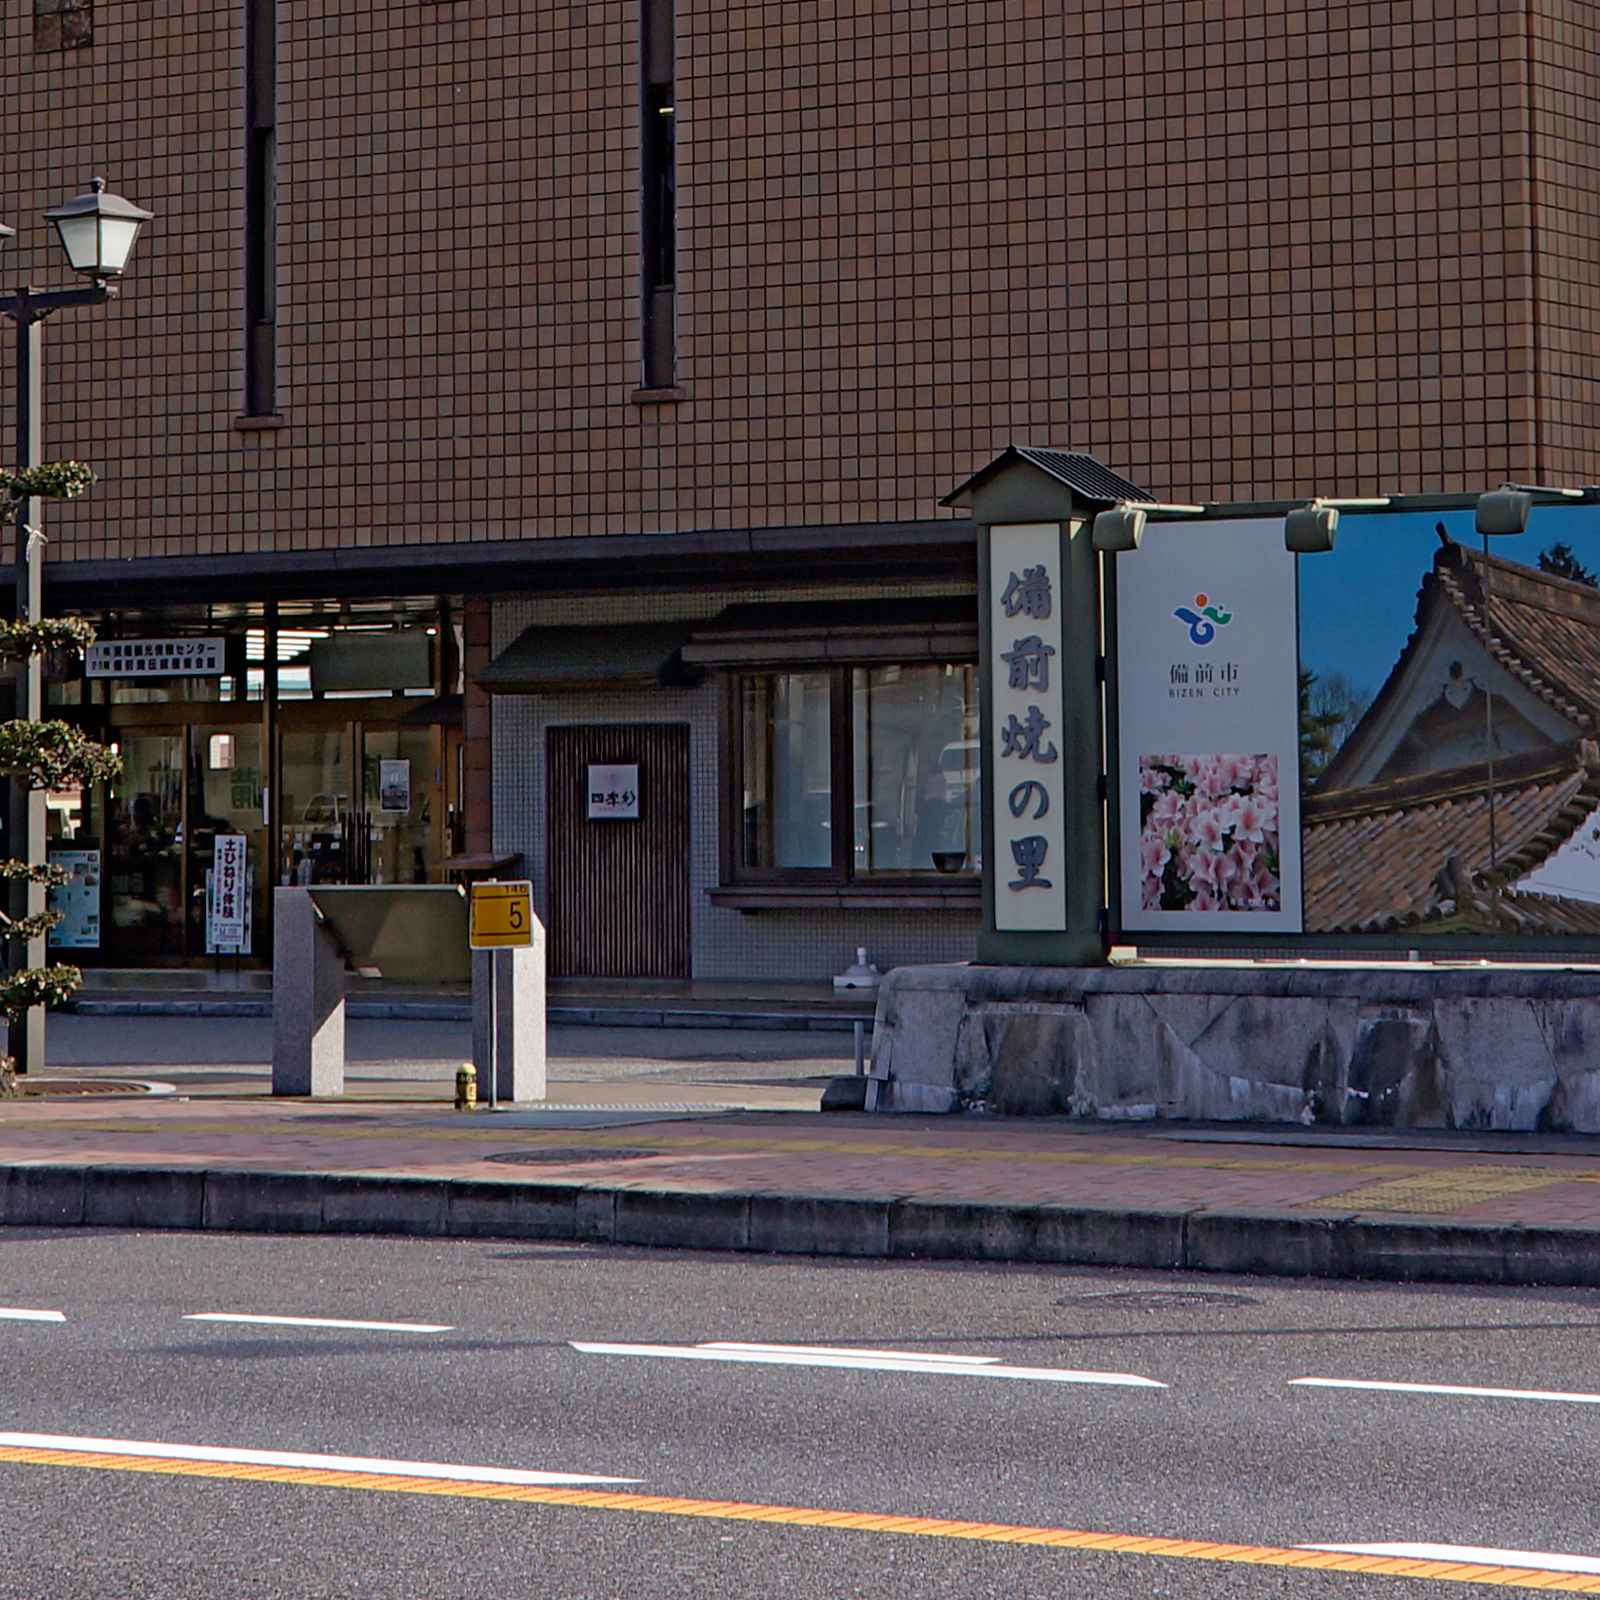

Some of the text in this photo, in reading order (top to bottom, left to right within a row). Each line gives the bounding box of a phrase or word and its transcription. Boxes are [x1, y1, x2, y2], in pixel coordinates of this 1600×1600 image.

[1170, 662, 1239, 683] 備前市
[1169, 687, 1240, 698] BIZEN CITY
[1000, 564, 1058, 890] 備前焼の里
[510, 901, 522, 929] 5
